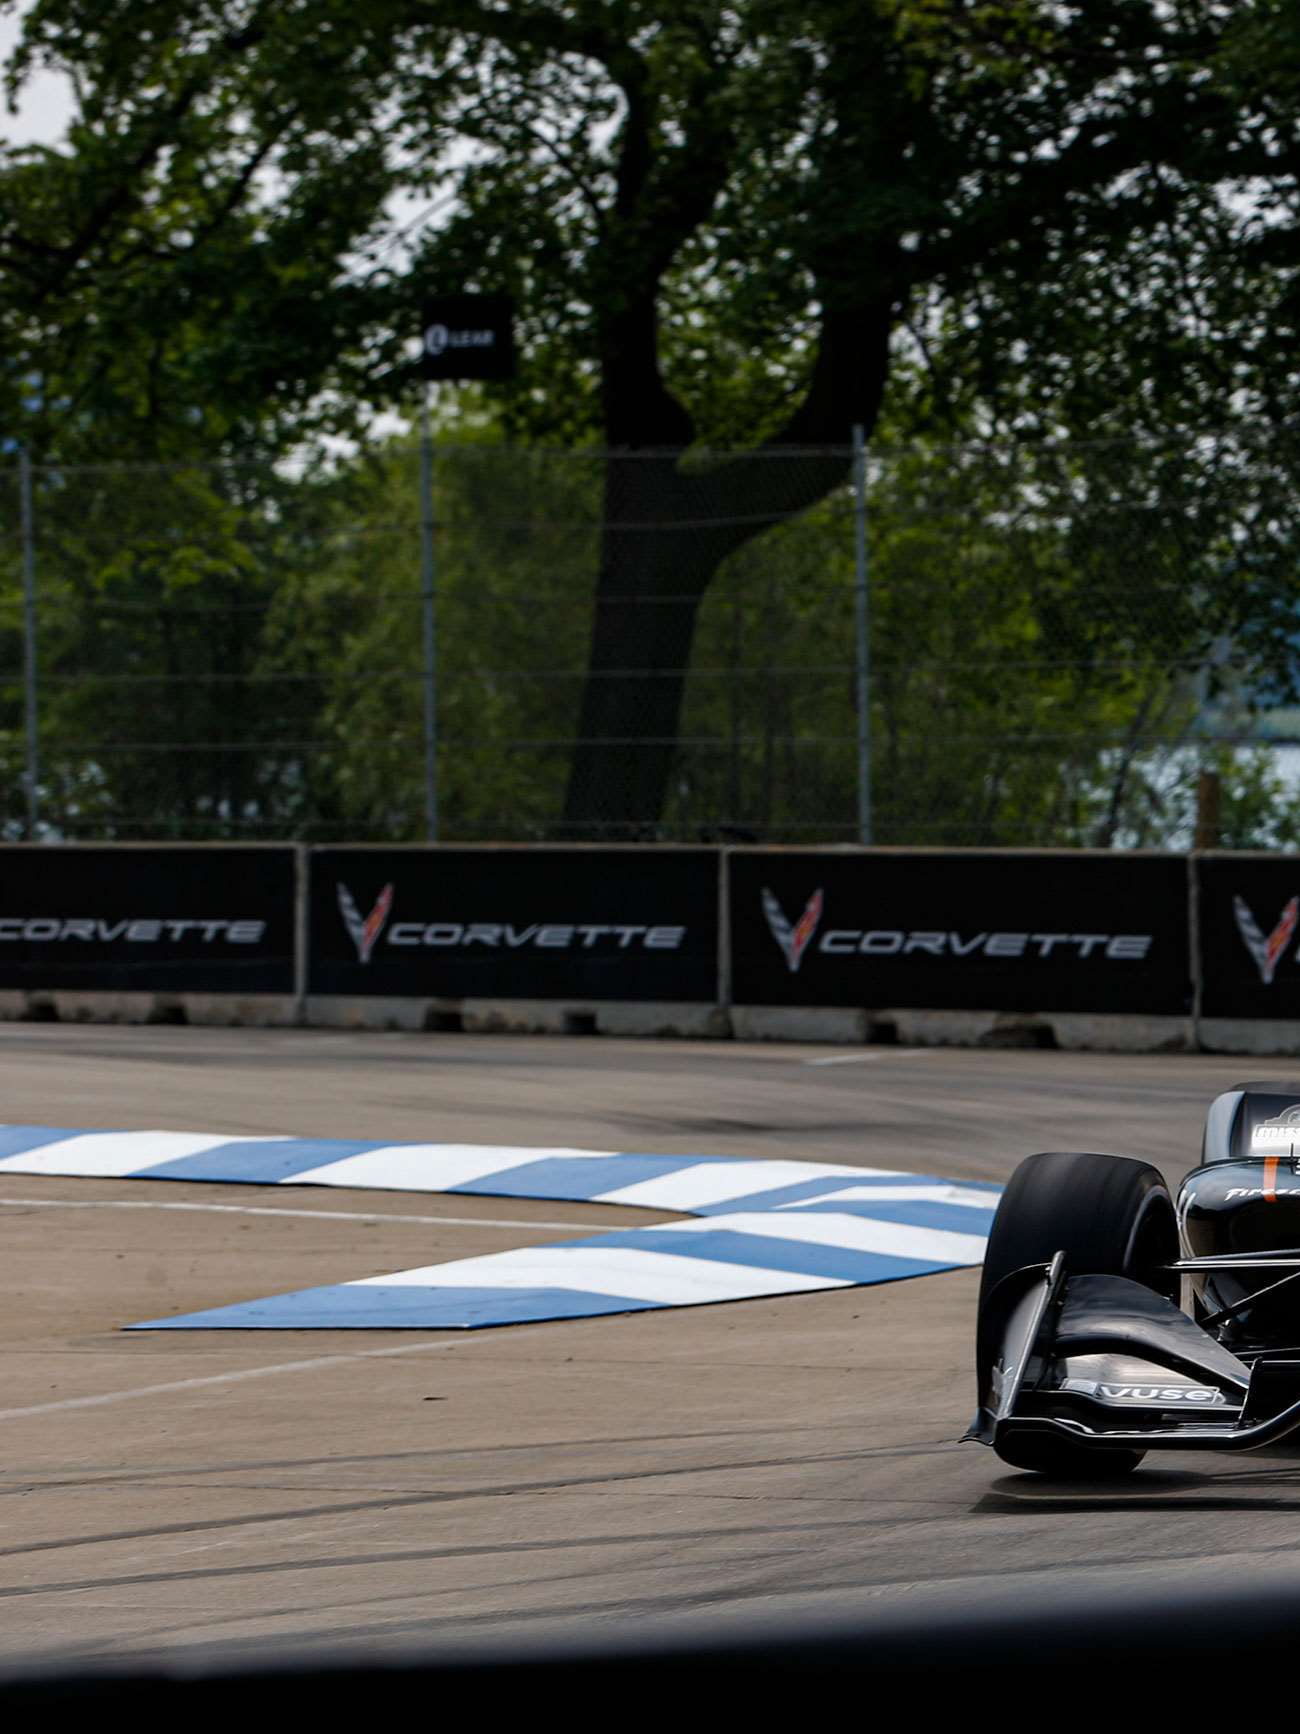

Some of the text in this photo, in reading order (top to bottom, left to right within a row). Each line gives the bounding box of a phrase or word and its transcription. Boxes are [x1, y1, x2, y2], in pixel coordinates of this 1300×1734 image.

[0, 918, 267, 945] CORVETTE
[387, 922, 687, 949] CORVETTE
[819, 929, 1154, 960] CORVETTE
[1100, 1386, 1213, 1401] vuse
